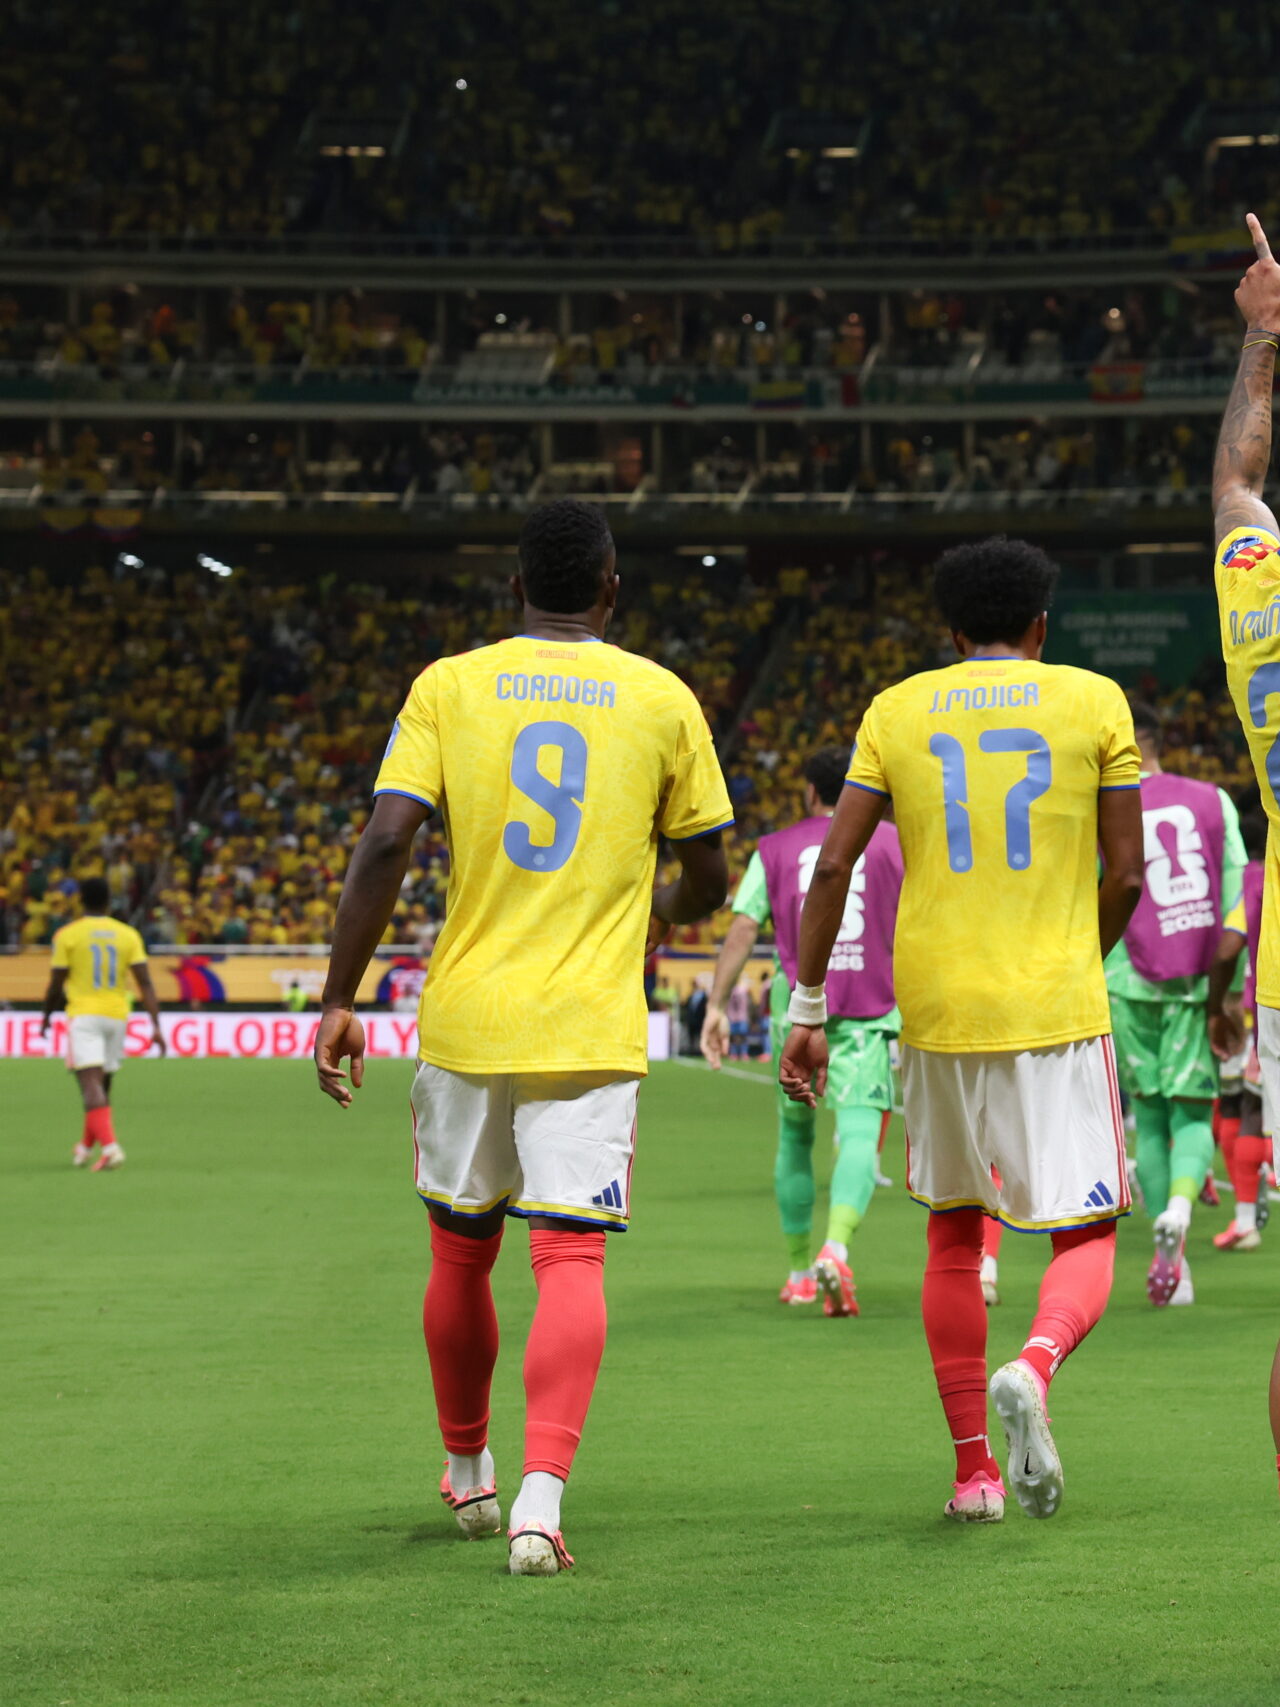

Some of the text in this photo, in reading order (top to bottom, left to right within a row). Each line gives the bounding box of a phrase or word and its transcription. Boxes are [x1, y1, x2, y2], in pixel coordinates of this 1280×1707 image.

[496, 673, 616, 708] CORDOBA
[928, 681, 1039, 714] J.MOJICA
[503, 720, 588, 872] 9
[929, 727, 1052, 874] 17
[90, 943, 117, 988] 11
[170, 1018, 418, 1057] GLOBLY
